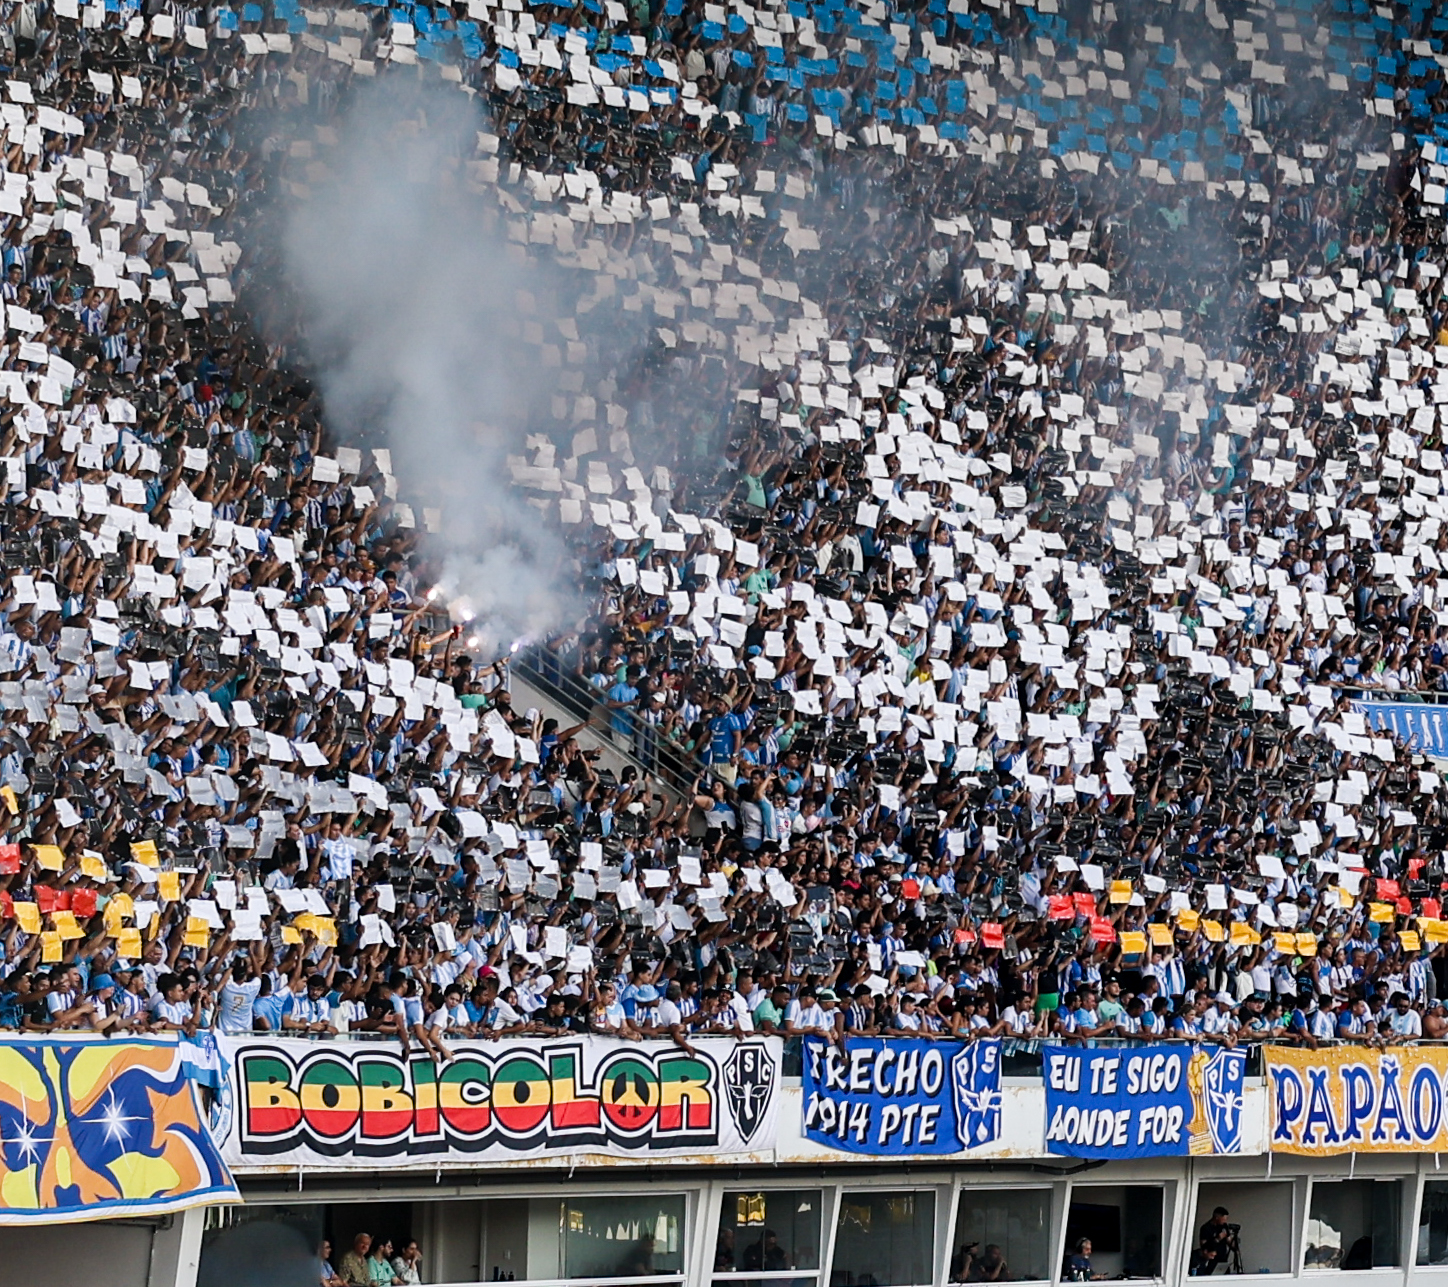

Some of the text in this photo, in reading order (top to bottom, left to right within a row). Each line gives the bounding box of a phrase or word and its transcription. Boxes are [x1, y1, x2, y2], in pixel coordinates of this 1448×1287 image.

[809, 1044, 944, 1097] TRECHO
[1050, 1054, 1182, 1094] EU TE SIGO
[240, 1044, 720, 1156] BOBICOLOR
[804, 1099, 939, 1145] 1914 PTE
[1271, 1054, 1442, 1147] PAPÃO
[1049, 1105, 1183, 1148] AONDE FOR
